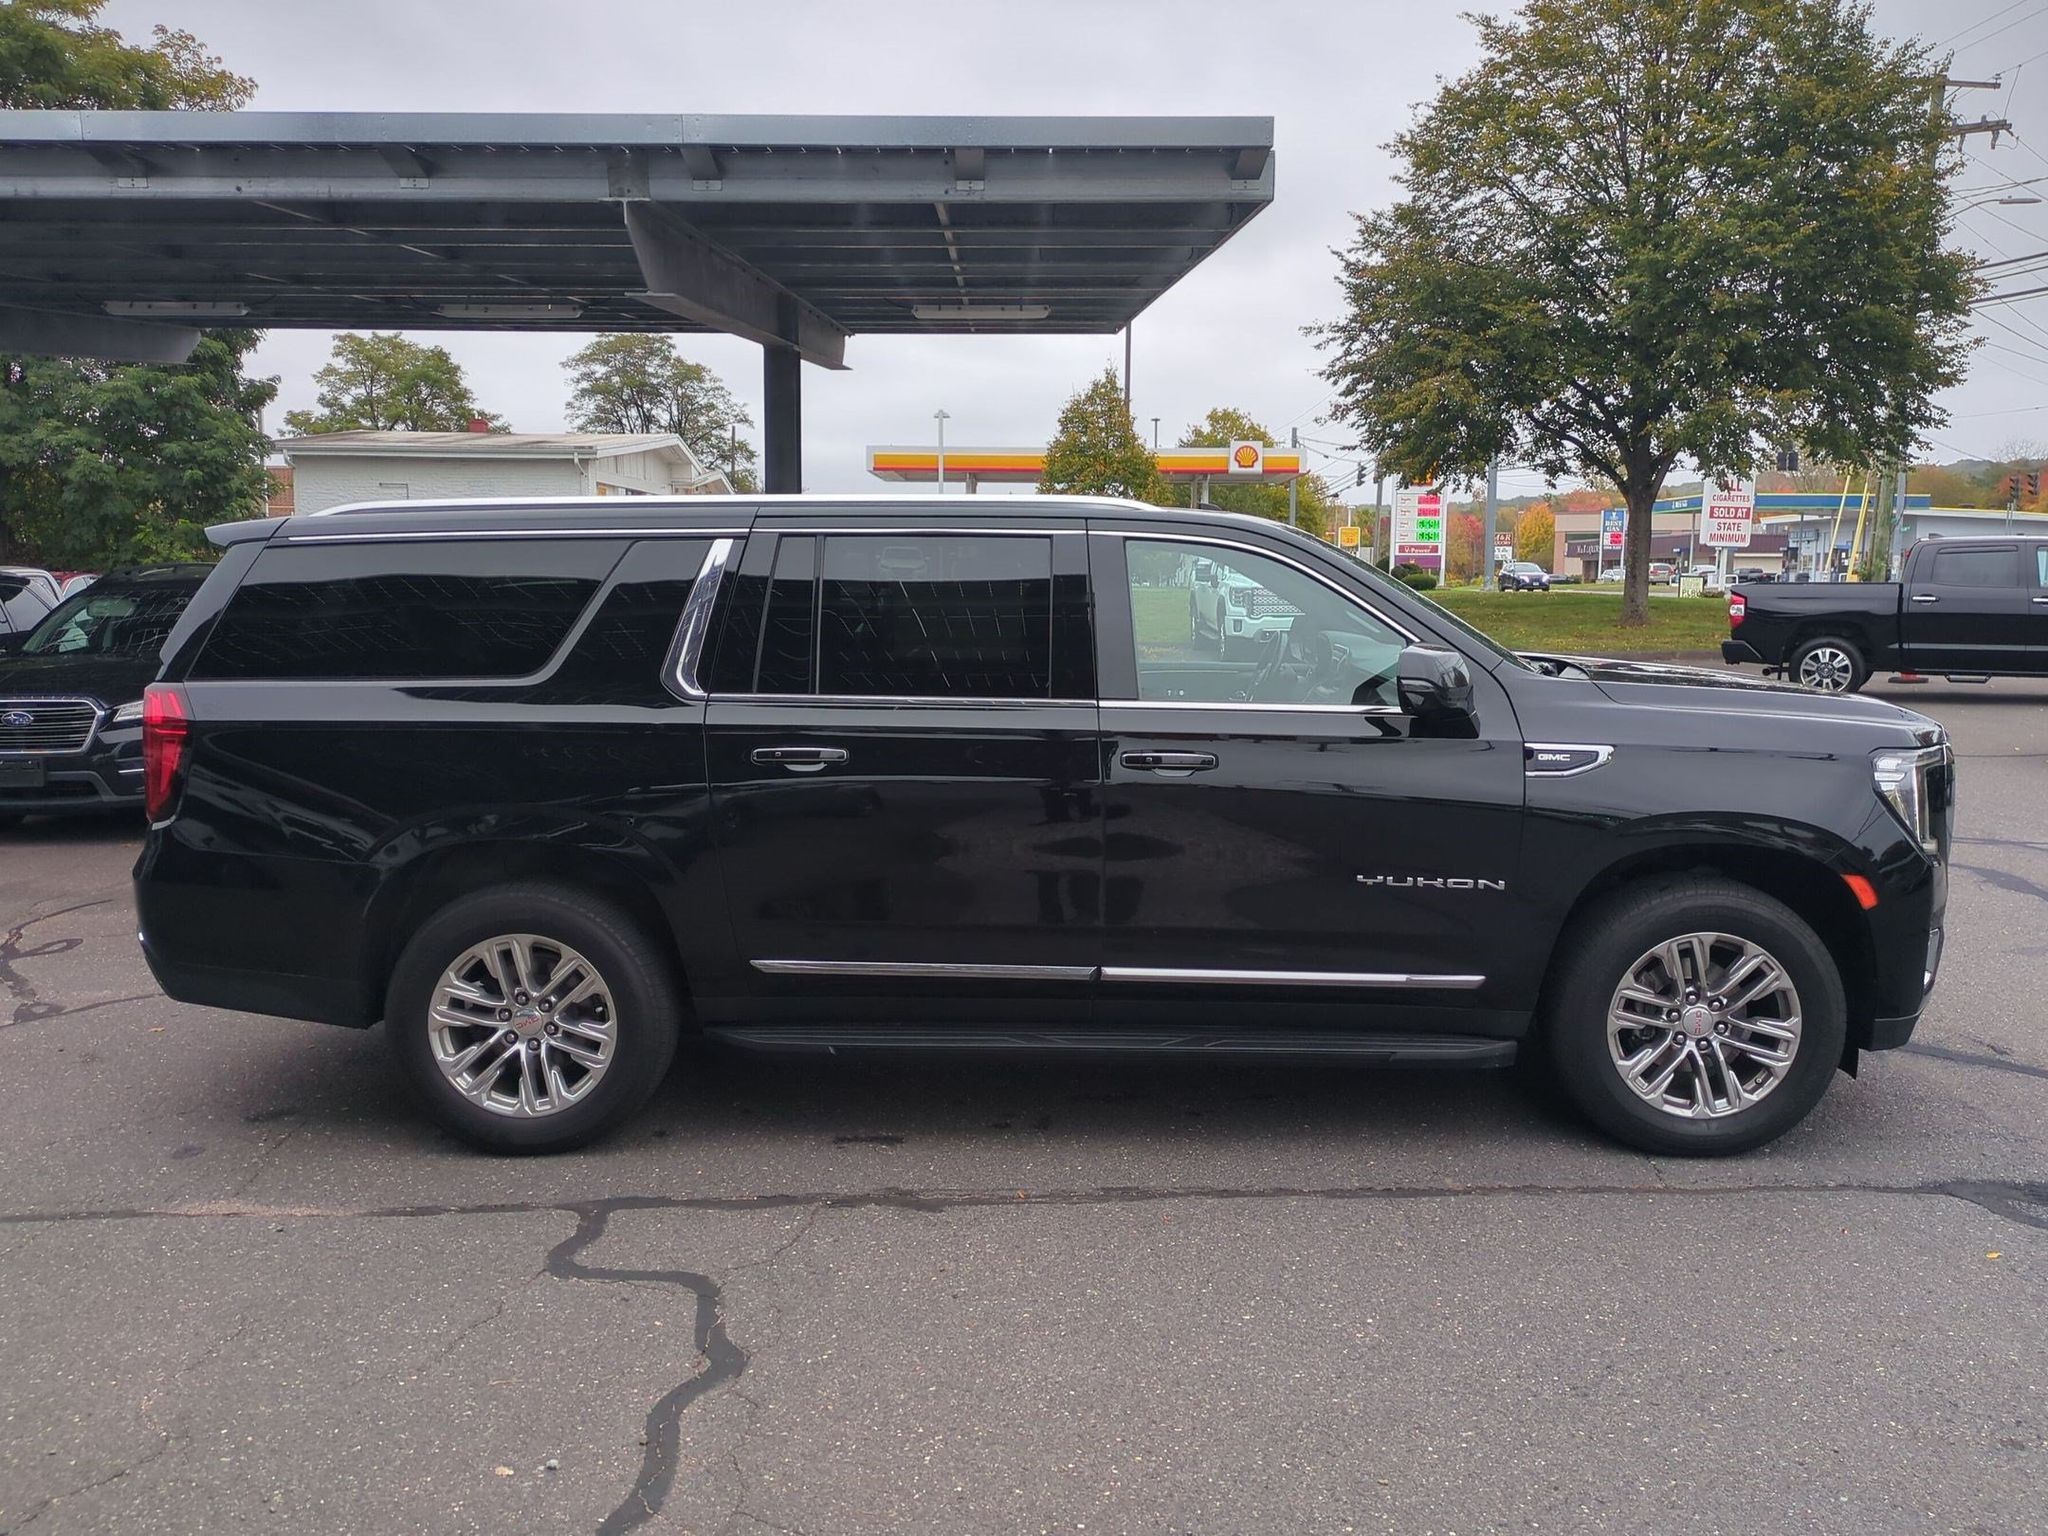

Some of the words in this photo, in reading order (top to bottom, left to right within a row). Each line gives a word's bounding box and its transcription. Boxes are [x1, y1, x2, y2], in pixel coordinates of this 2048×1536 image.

[1712, 494, 1750, 502] CIGARETTES
[1713, 507, 1735, 518] SOLD
[1736, 508, 1748, 518] AT
[1717, 521, 1742, 531] STATE
[1709, 533, 1748, 543] MINIMUM
[1538, 753, 1570, 761] GMC
[1356, 874, 1505, 891] YUKON
